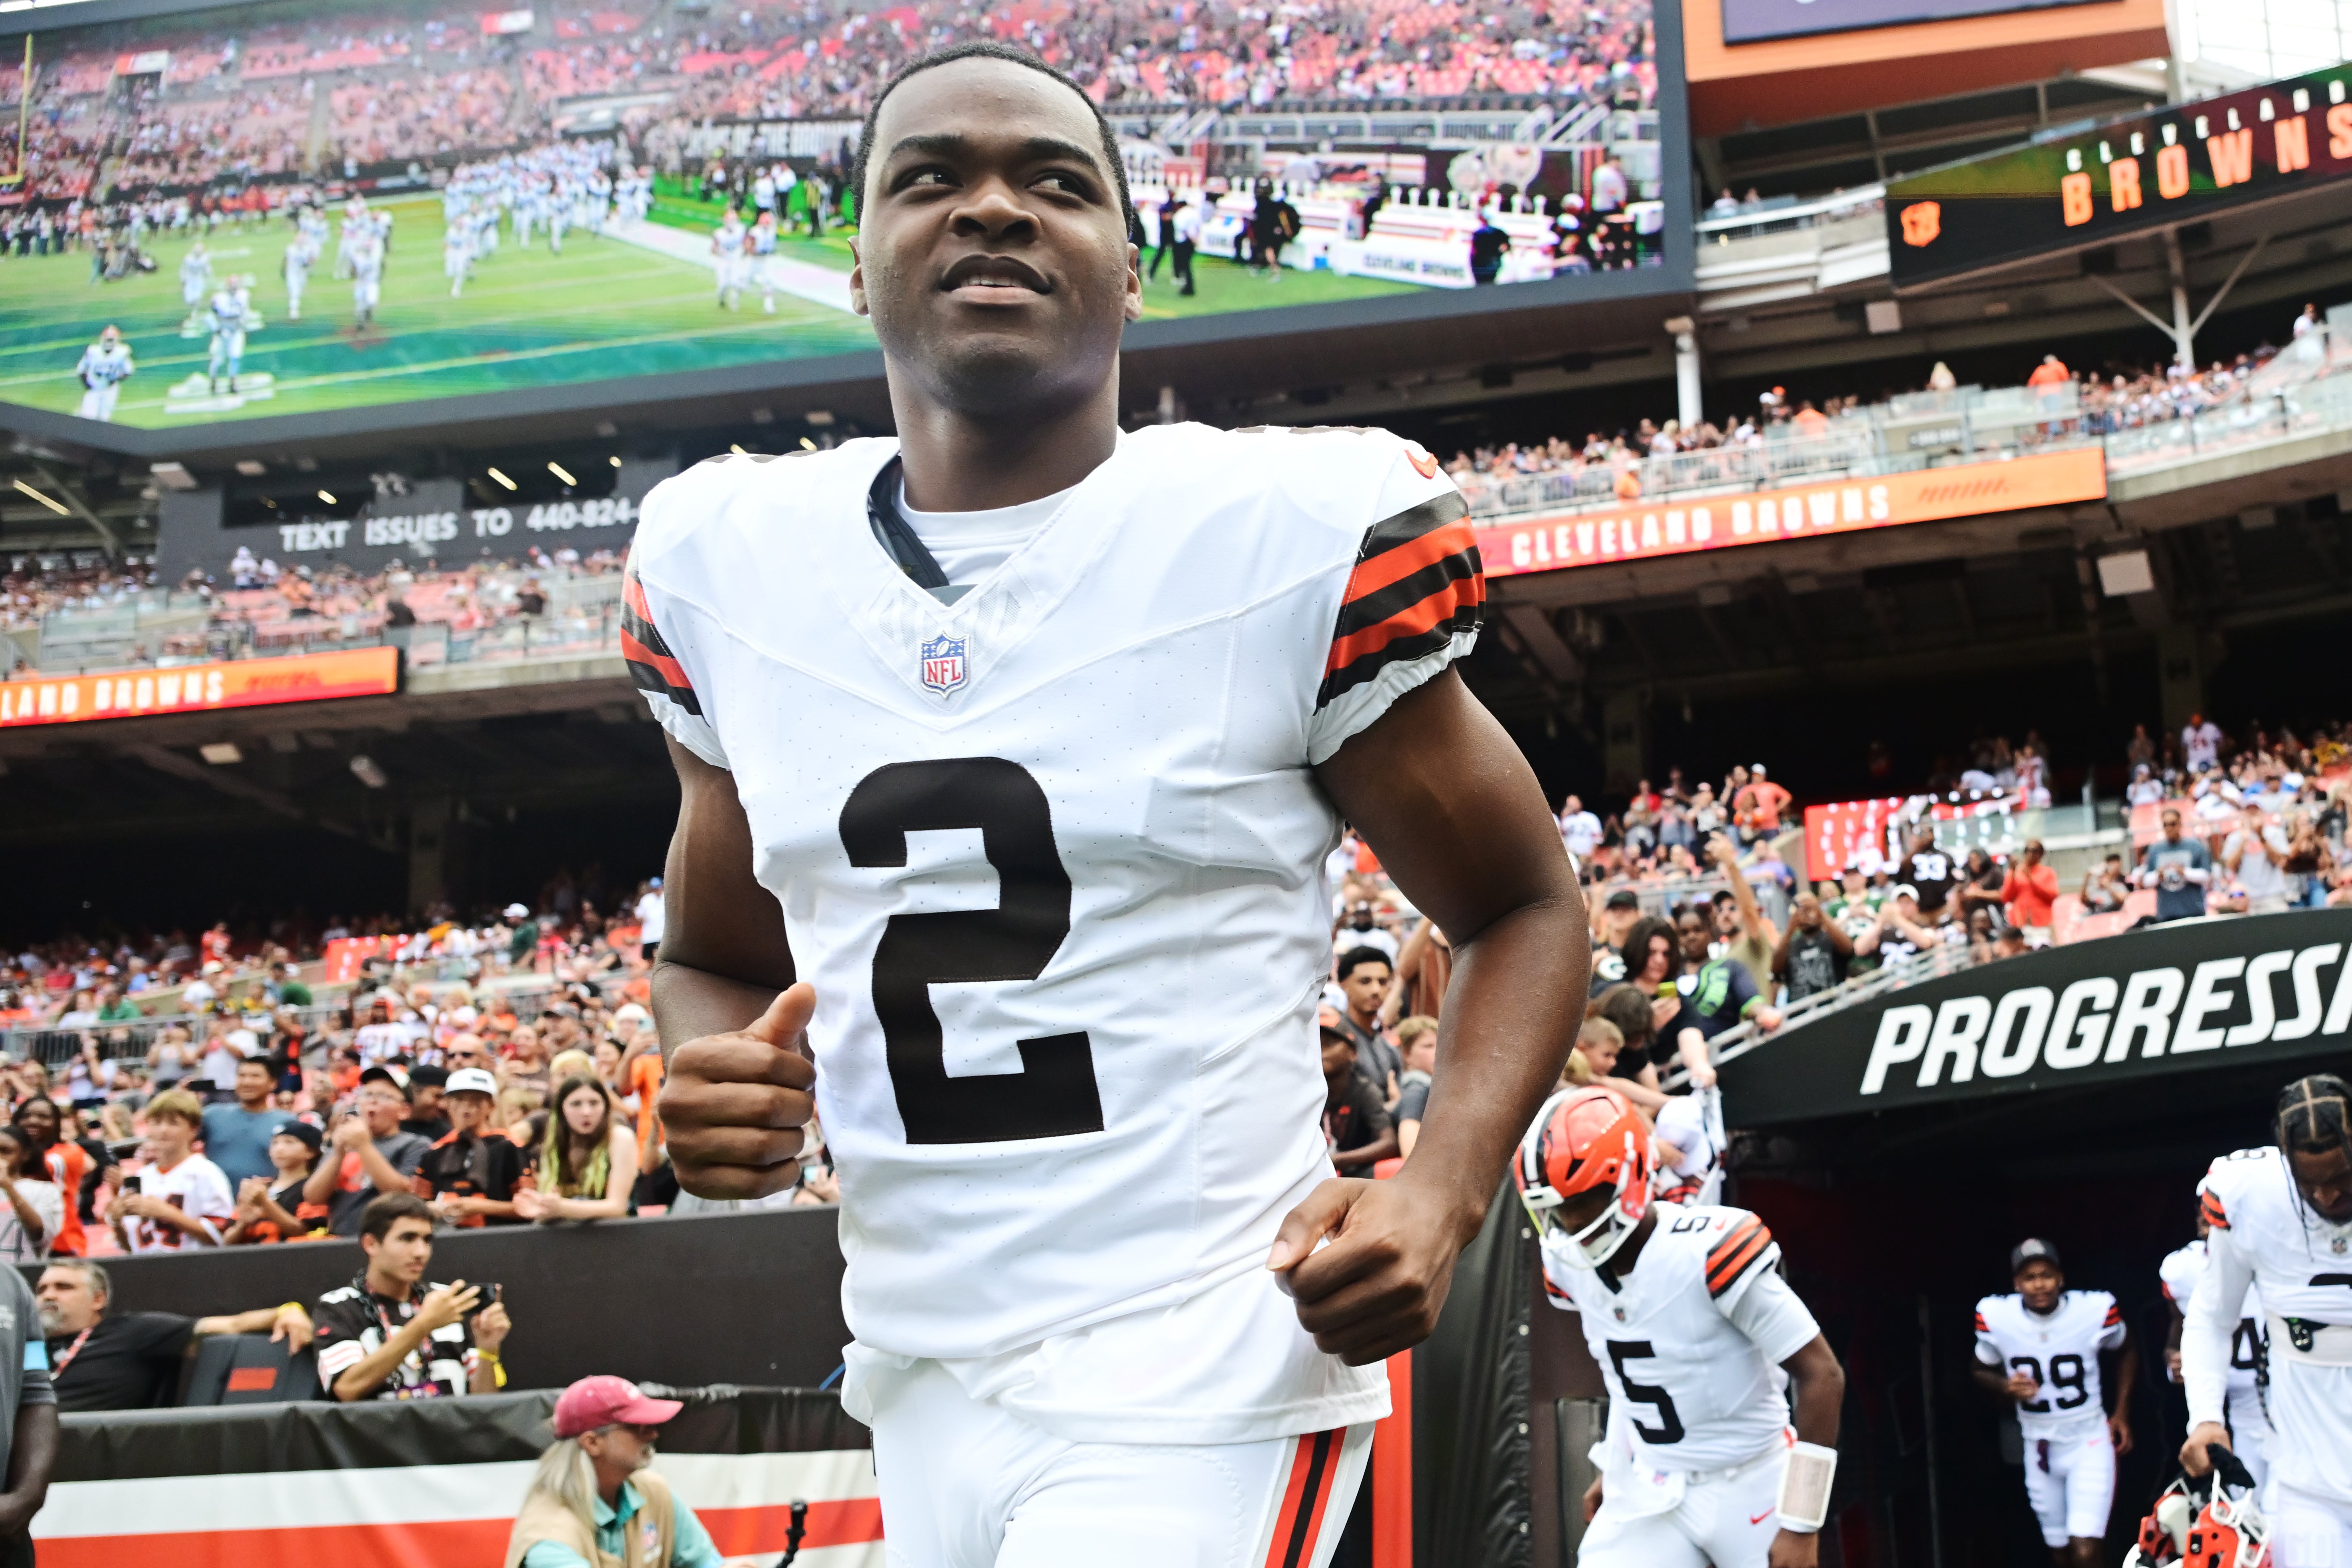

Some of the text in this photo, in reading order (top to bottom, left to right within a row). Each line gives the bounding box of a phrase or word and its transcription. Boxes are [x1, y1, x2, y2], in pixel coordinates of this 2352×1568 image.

[2066, 79, 2347, 172] CLEVELAND
[2061, 103, 2352, 227] BROWNS
[279, 520, 351, 552] TEXT
[364, 512, 459, 546] ISSUES
[471, 507, 514, 538] TO
[1511, 485, 1890, 568] CLEVELAND BROWNS
[1, 671, 224, 720] LAND BROWNS
[926, 659, 961, 685] NFL
[1911, 853, 1948, 882] 33
[839, 756, 1105, 1145] 2
[1671, 1216, 1711, 1234] 5
[1606, 1340, 1685, 1444] 5
[2011, 1354, 2088, 1412] 29
